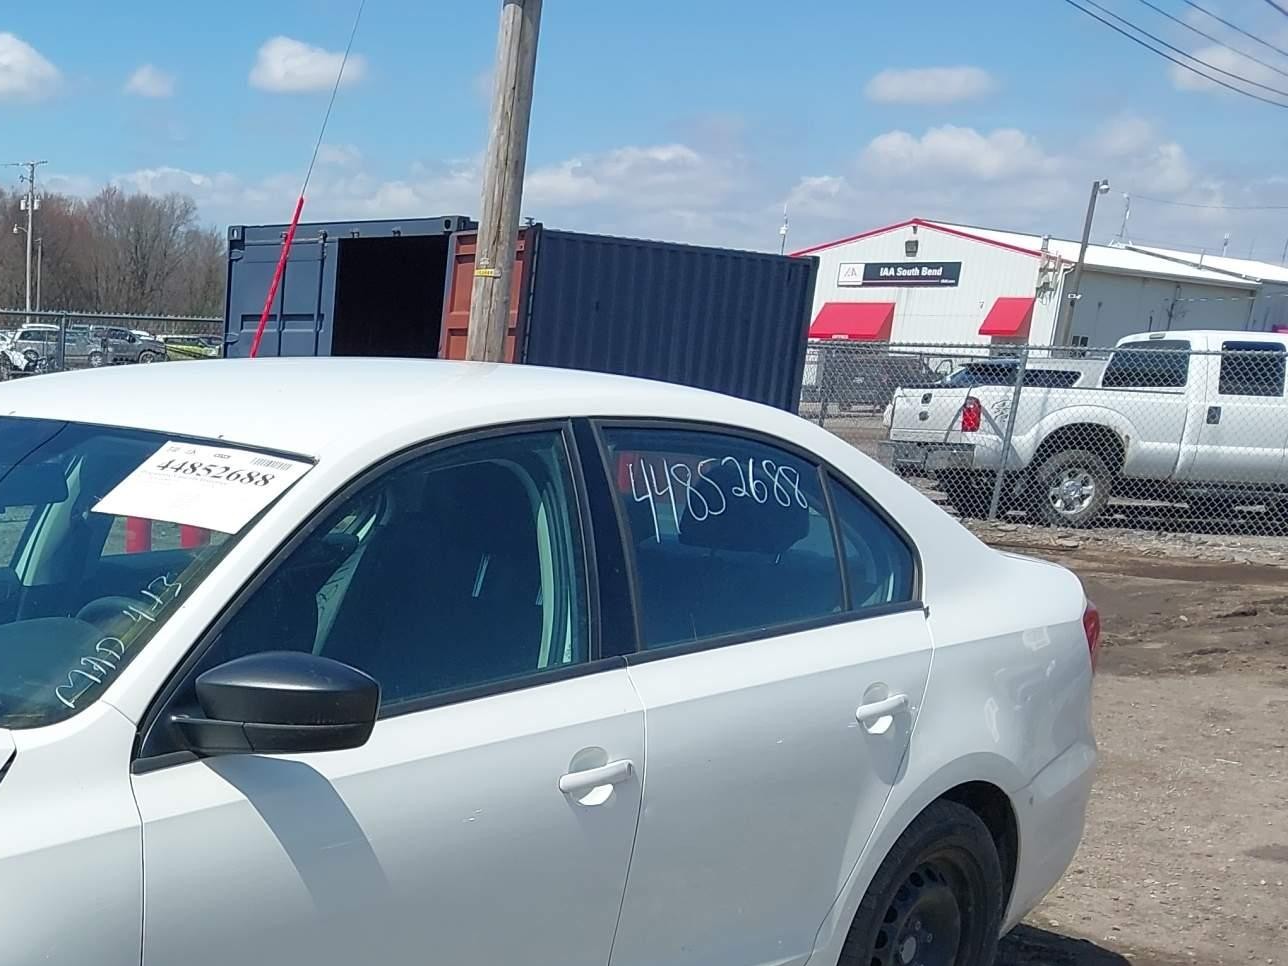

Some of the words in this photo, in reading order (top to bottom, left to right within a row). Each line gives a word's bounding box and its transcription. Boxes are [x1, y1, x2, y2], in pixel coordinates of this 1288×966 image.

[879, 266, 895, 277] IAA
[896, 266, 920, 277] South
[921, 266, 943, 277] Bend
[155, 458, 276, 488] 44852688
[627, 456, 809, 544] 44852688
